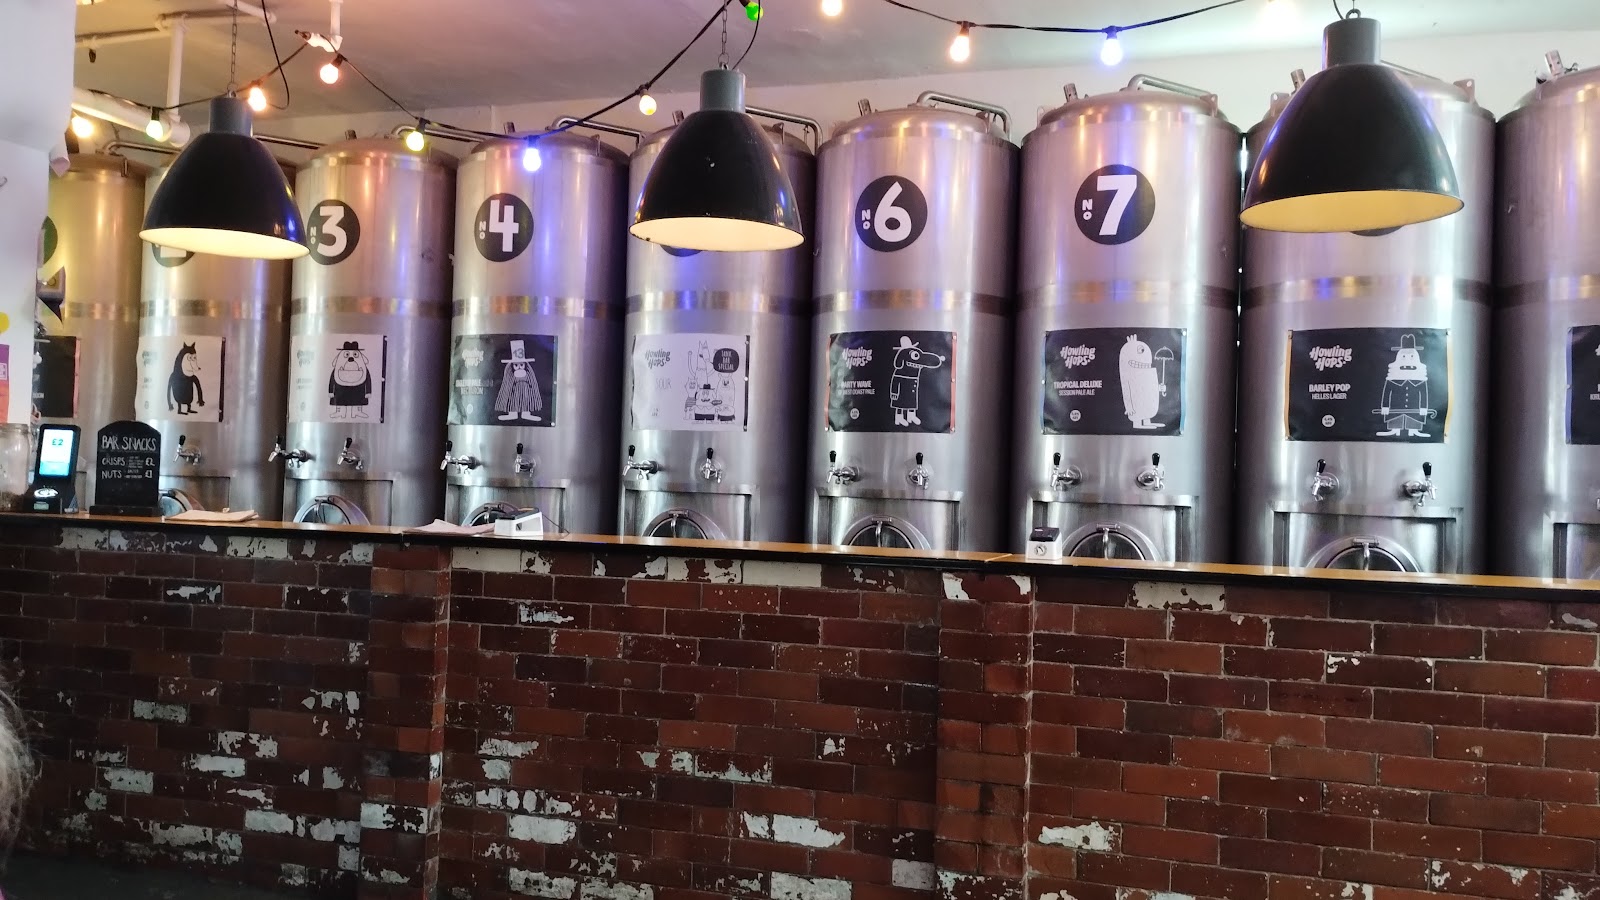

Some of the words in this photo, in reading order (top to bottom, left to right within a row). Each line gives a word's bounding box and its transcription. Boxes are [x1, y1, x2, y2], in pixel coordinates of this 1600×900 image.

[873, 181, 912, 243] 6
[1096, 174, 1138, 236] 7
[316, 205, 348, 257] 3
[488, 199, 520, 253] 4
[842, 346, 873, 361] Howling
[1060, 344, 1096, 360] Howling
[1309, 345, 1353, 361] Howling
[857, 380, 872, 388] WAVE
[1054, 381, 1080, 389] TROPICAL
[1080, 380, 1103, 388] DELUXE
[1309, 384, 1335, 393] BARLEY
[1335, 384, 1351, 392] POP
[52, 438, 63, 446] £2
[102, 434, 120, 450] BAR
[121, 436, 157, 451] SNACKS
[101, 457, 126, 467] CRISPS
[101, 470, 122, 479] NUTS
